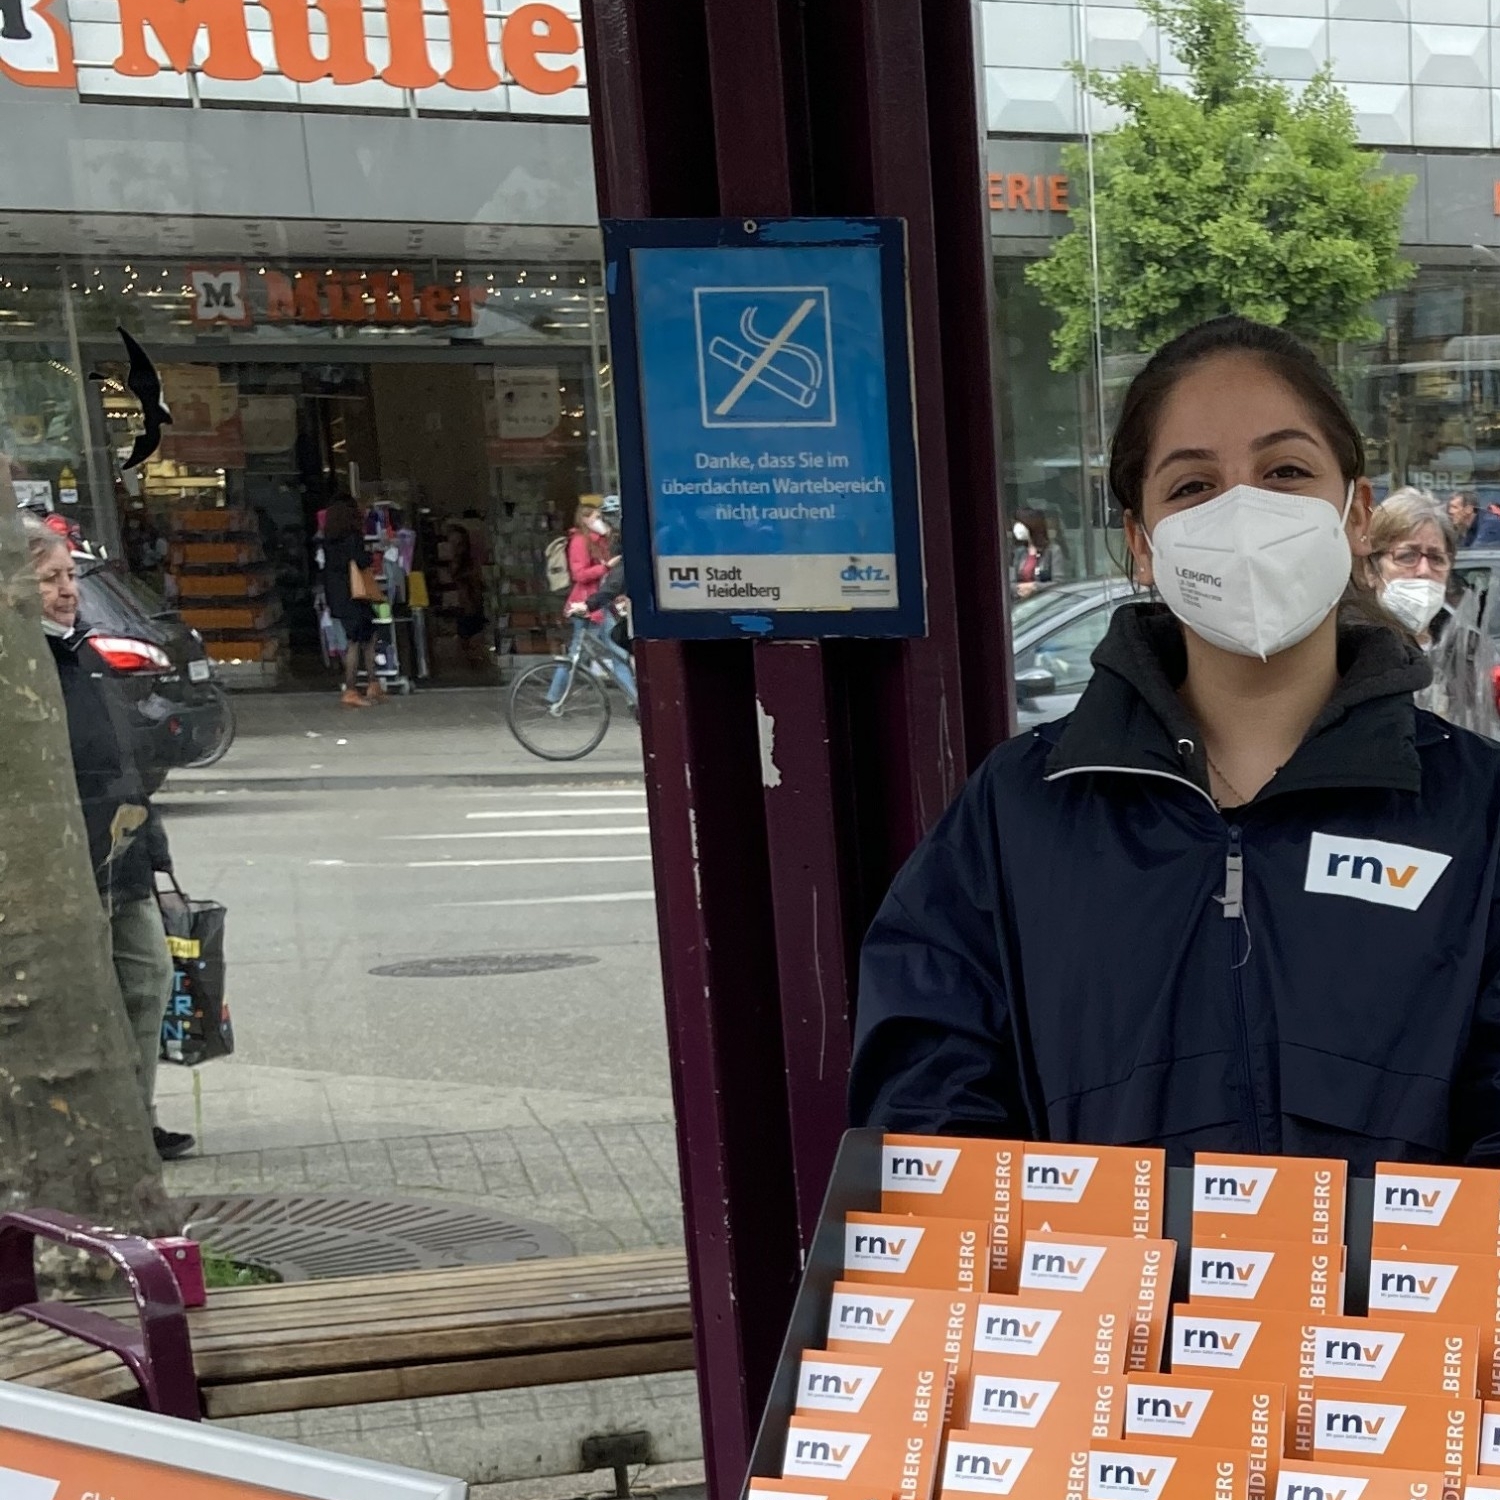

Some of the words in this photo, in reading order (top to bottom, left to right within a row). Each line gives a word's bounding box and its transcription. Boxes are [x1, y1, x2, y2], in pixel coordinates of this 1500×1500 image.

[266, 268, 484, 324] Müller
[695, 452, 755, 471] Danke,
[758, 452, 795, 468] dass
[798, 452, 825, 468] Sie
[827, 452, 849, 468] im
[661, 478, 770, 495] überdachten
[772, 476, 886, 494] Wartebereich
[716, 504, 760, 520] nicht
[762, 503, 835, 520] rauchen!
[705, 566, 742, 581] Stadt
[1175, 566, 1222, 588] LEIKANG
[706, 583, 781, 601] Heidelberg
[1326, 852, 1419, 888] rnv
[891, 1156, 944, 1178] rnv
[992, 1150, 1012, 1270] HEIDELBERG
[1099, 1463, 1157, 1486] rnv
